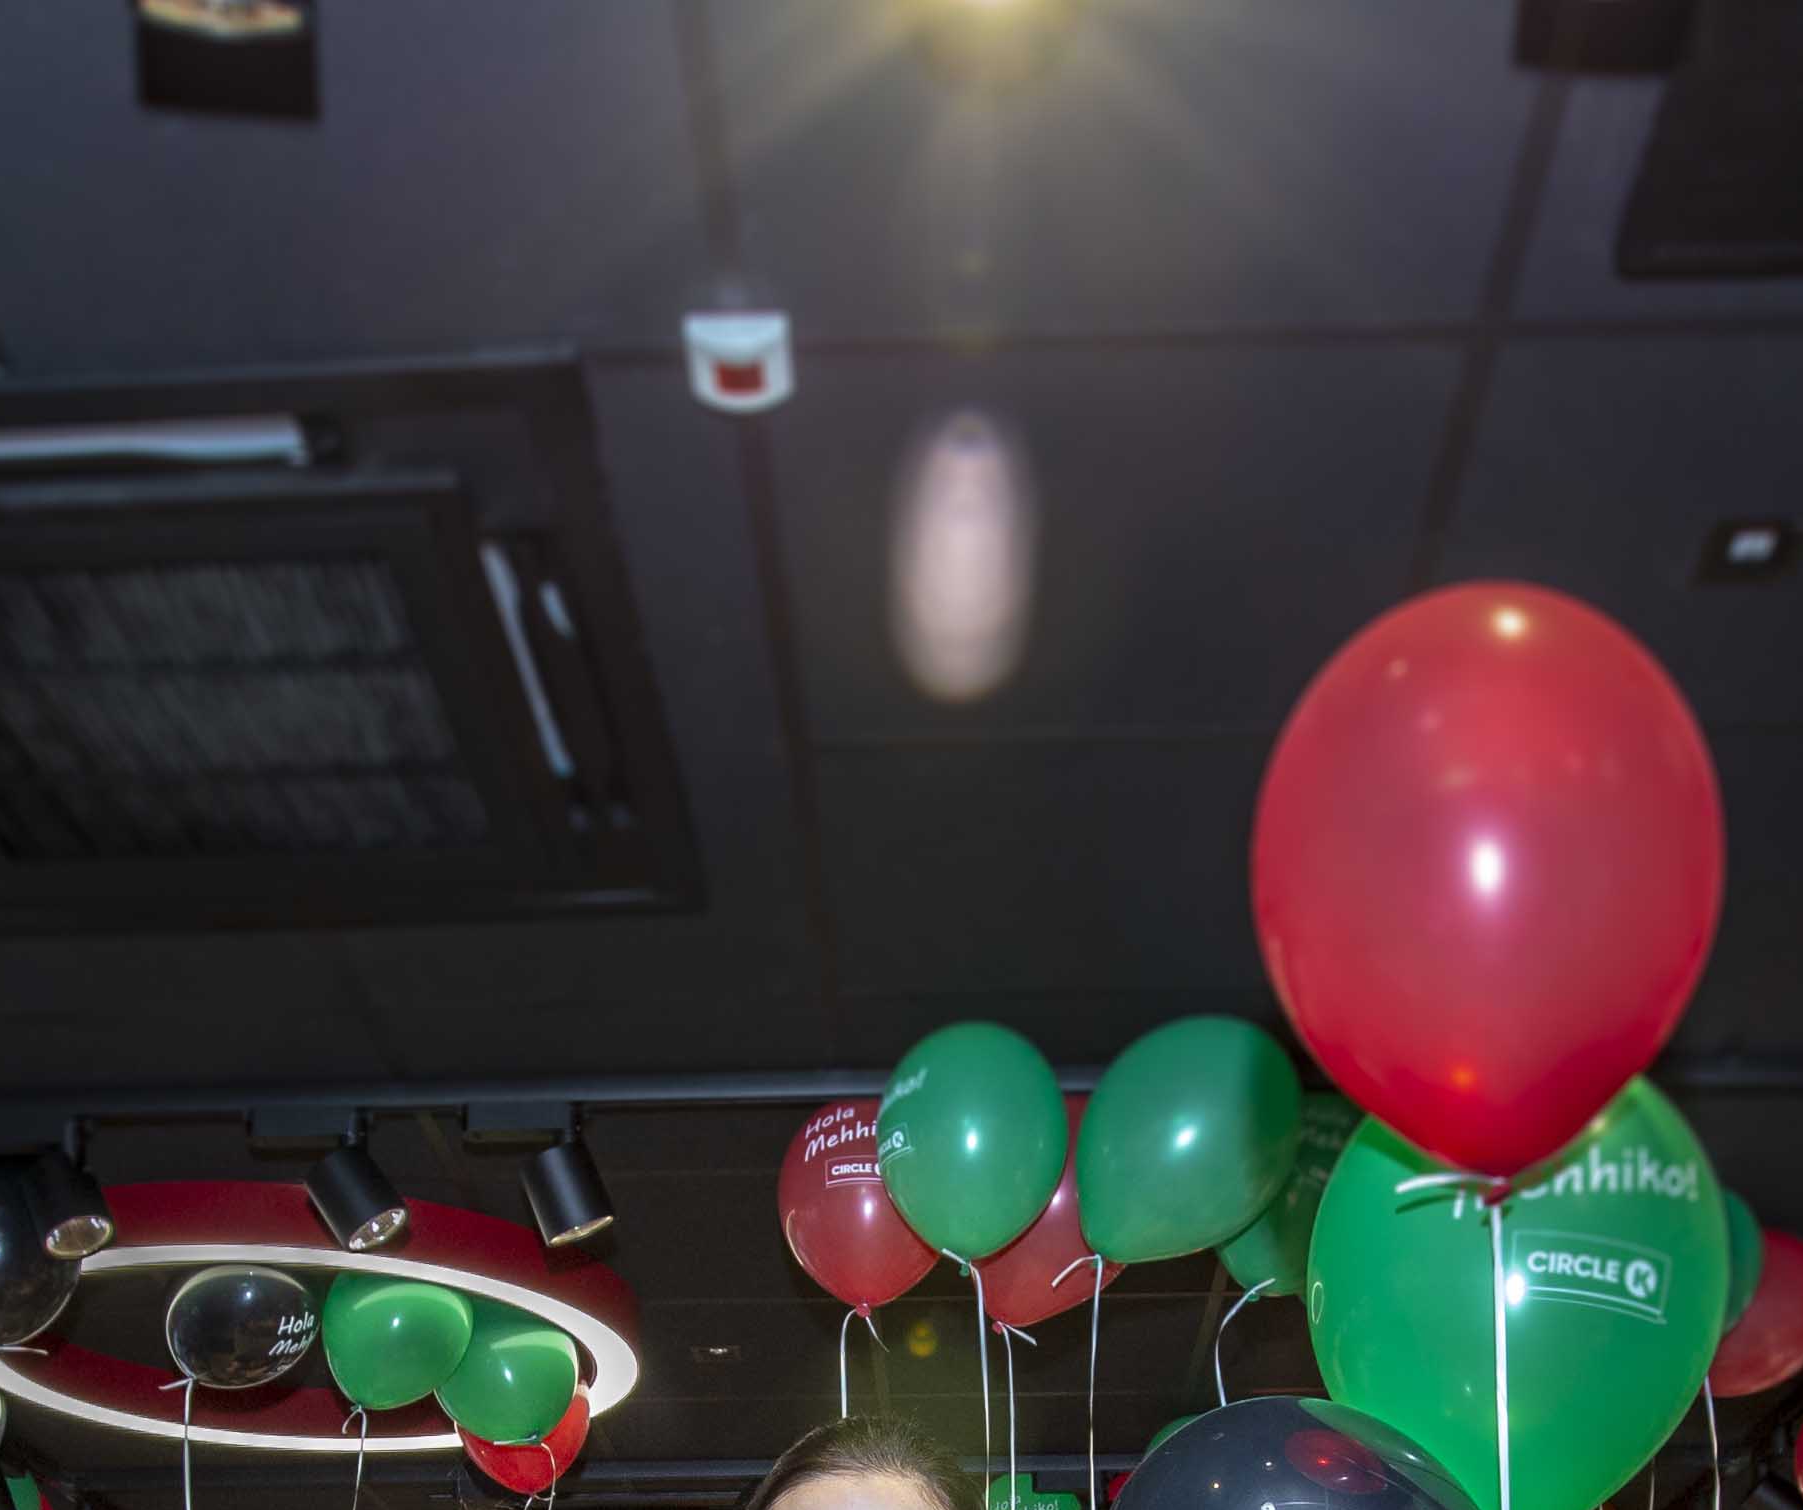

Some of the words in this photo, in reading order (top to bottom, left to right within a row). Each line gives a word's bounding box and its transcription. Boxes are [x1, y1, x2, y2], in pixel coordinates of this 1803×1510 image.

[804, 1107, 855, 1139] Hola
[831, 1163, 873, 1176] CIRCLE
[1526, 1250, 1621, 1284] CIRCLE
[277, 1311, 315, 1336] Hola
